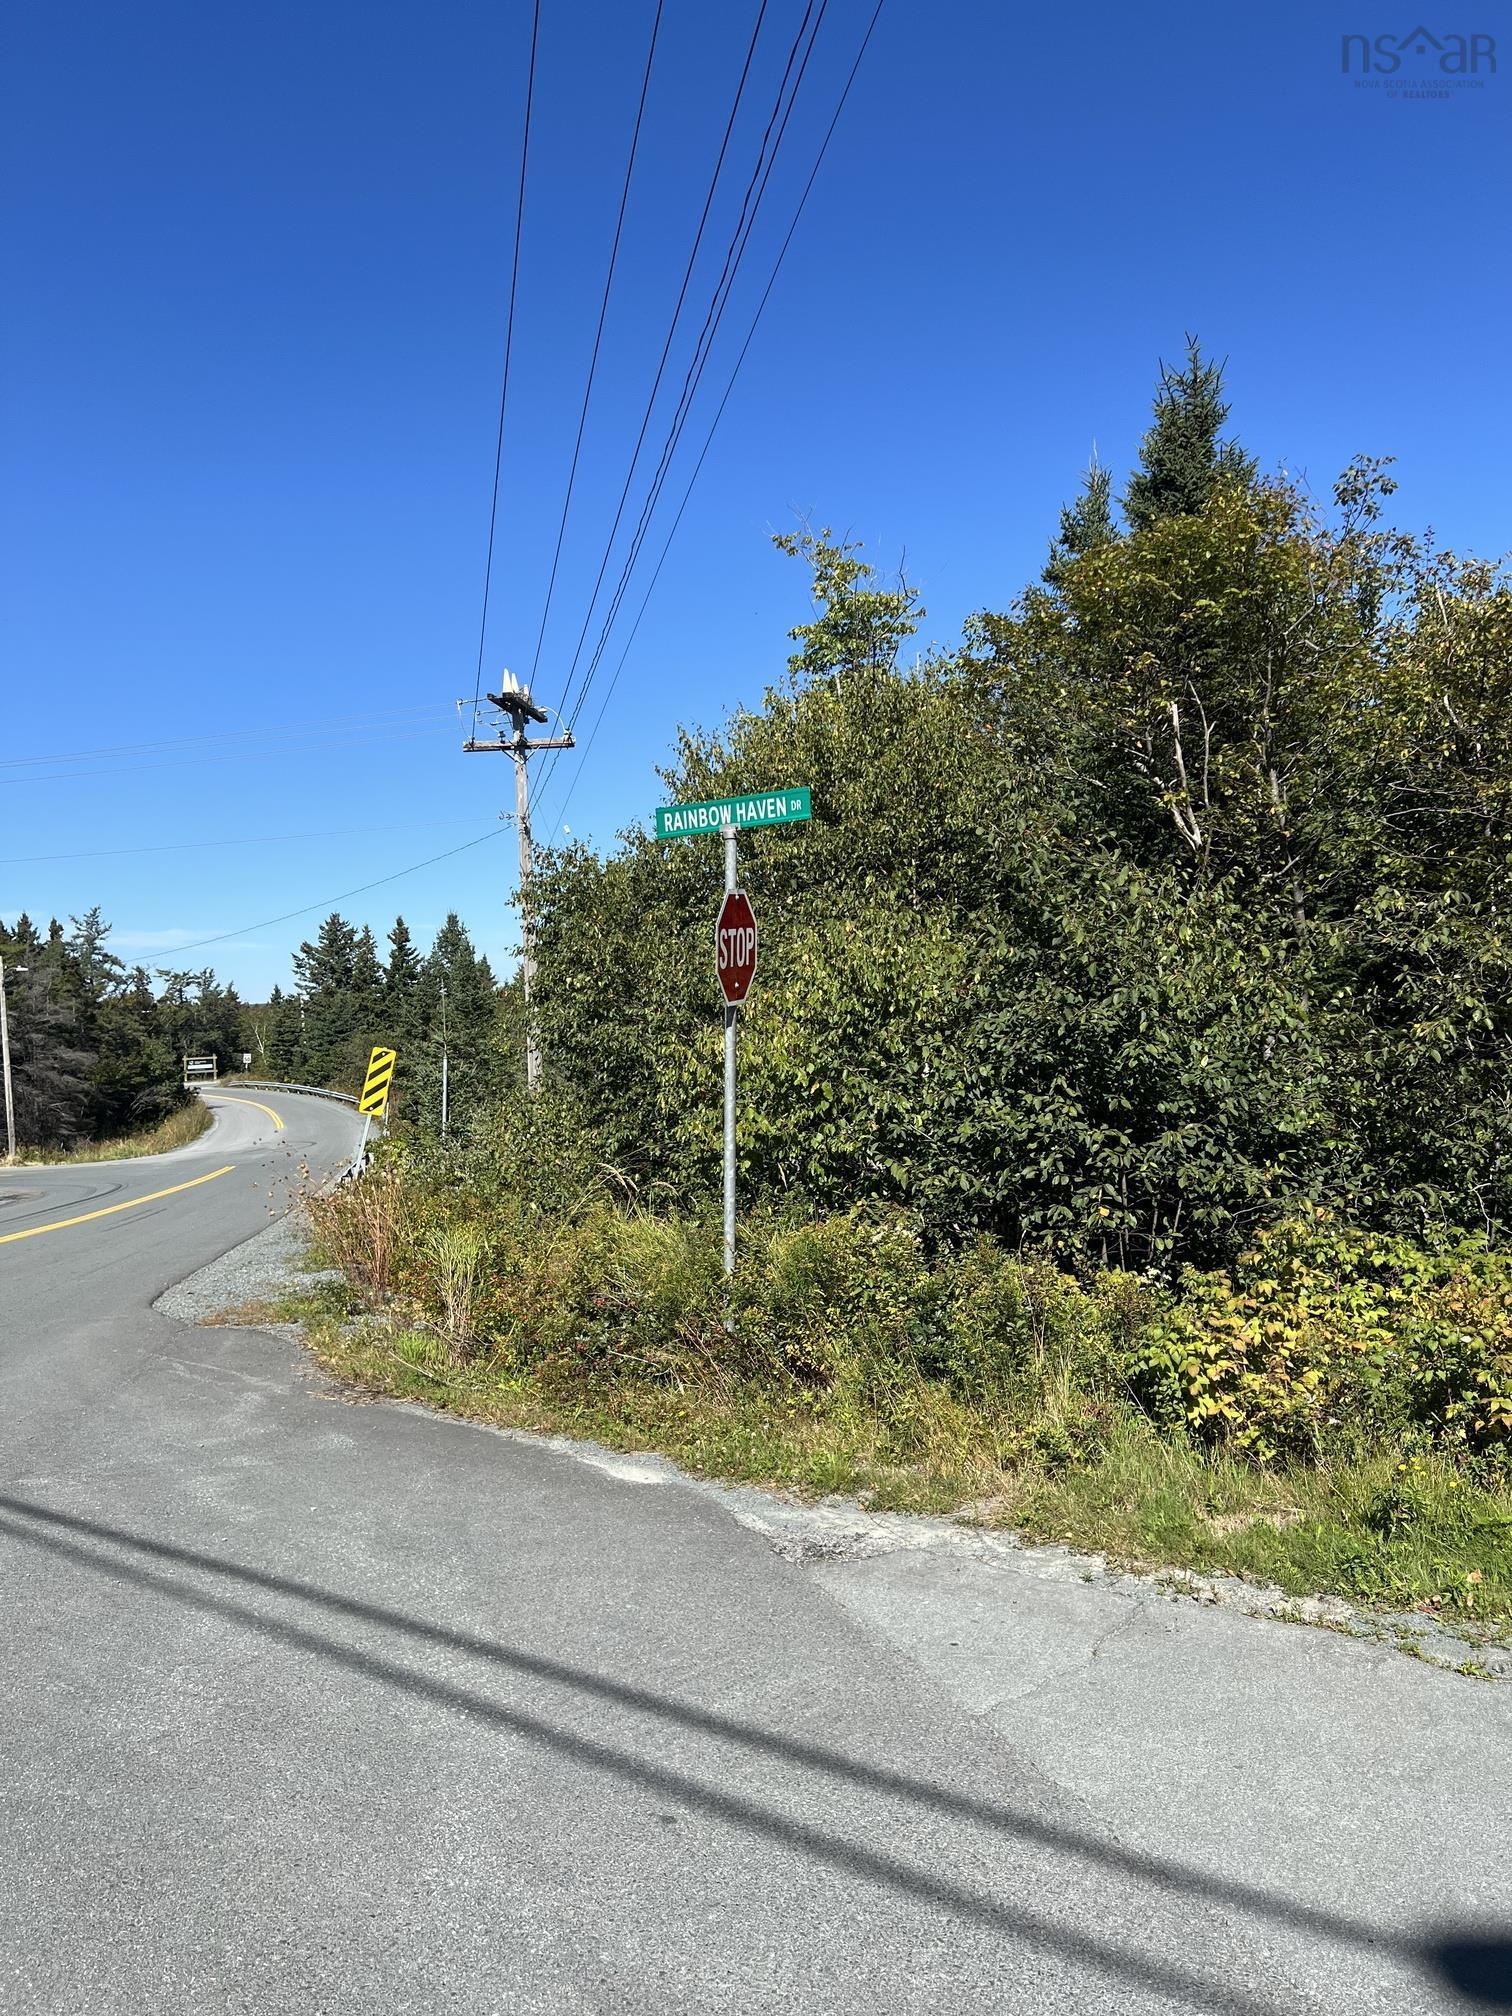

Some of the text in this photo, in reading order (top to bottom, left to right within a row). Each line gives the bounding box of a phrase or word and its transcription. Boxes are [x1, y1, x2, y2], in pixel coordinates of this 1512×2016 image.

[663, 796, 802, 832] RAINBOW HAVEN DR
[718, 927, 754, 970] STOP
